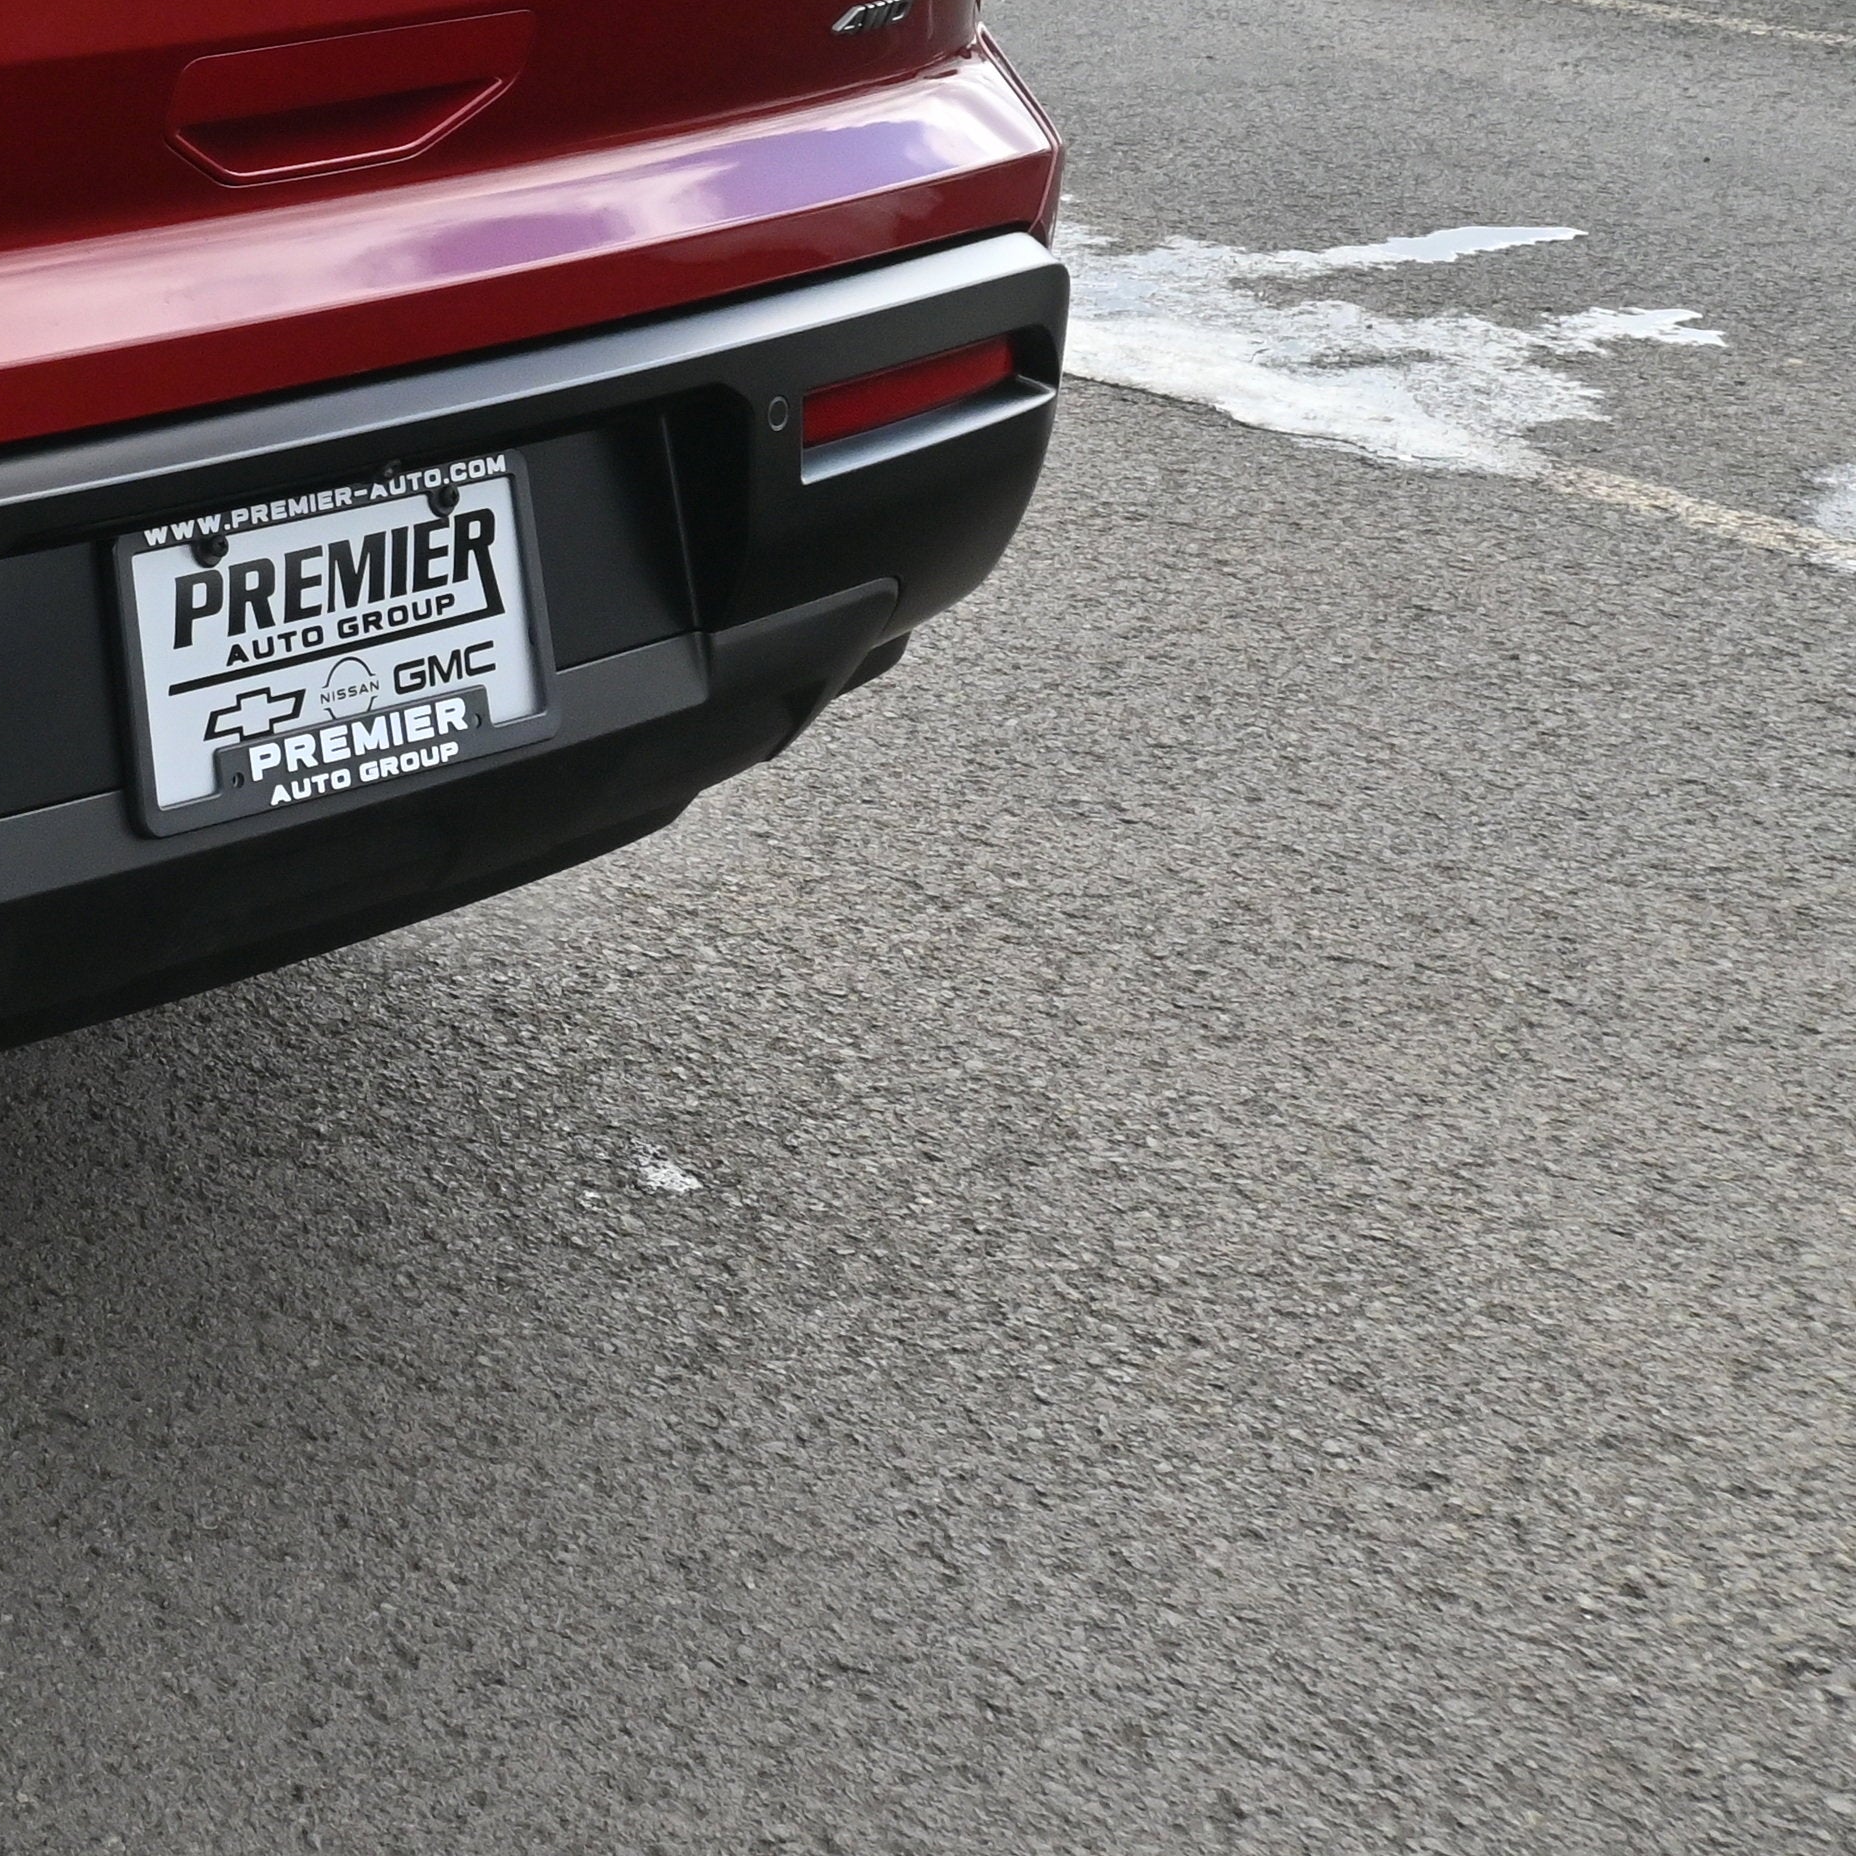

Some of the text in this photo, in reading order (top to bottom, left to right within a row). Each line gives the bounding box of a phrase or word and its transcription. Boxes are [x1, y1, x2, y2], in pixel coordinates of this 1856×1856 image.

[144, 454, 507, 547] WWW.PREMIER-AUTO.COM
[172, 507, 505, 650] PREMIER
[226, 592, 456, 666] AUTO GROUP
[319, 675, 381, 705] NISSAN
[393, 640, 497, 695] GMC
[248, 697, 469, 782] PREMIER
[269, 741, 459, 806] AUTO GROUP
